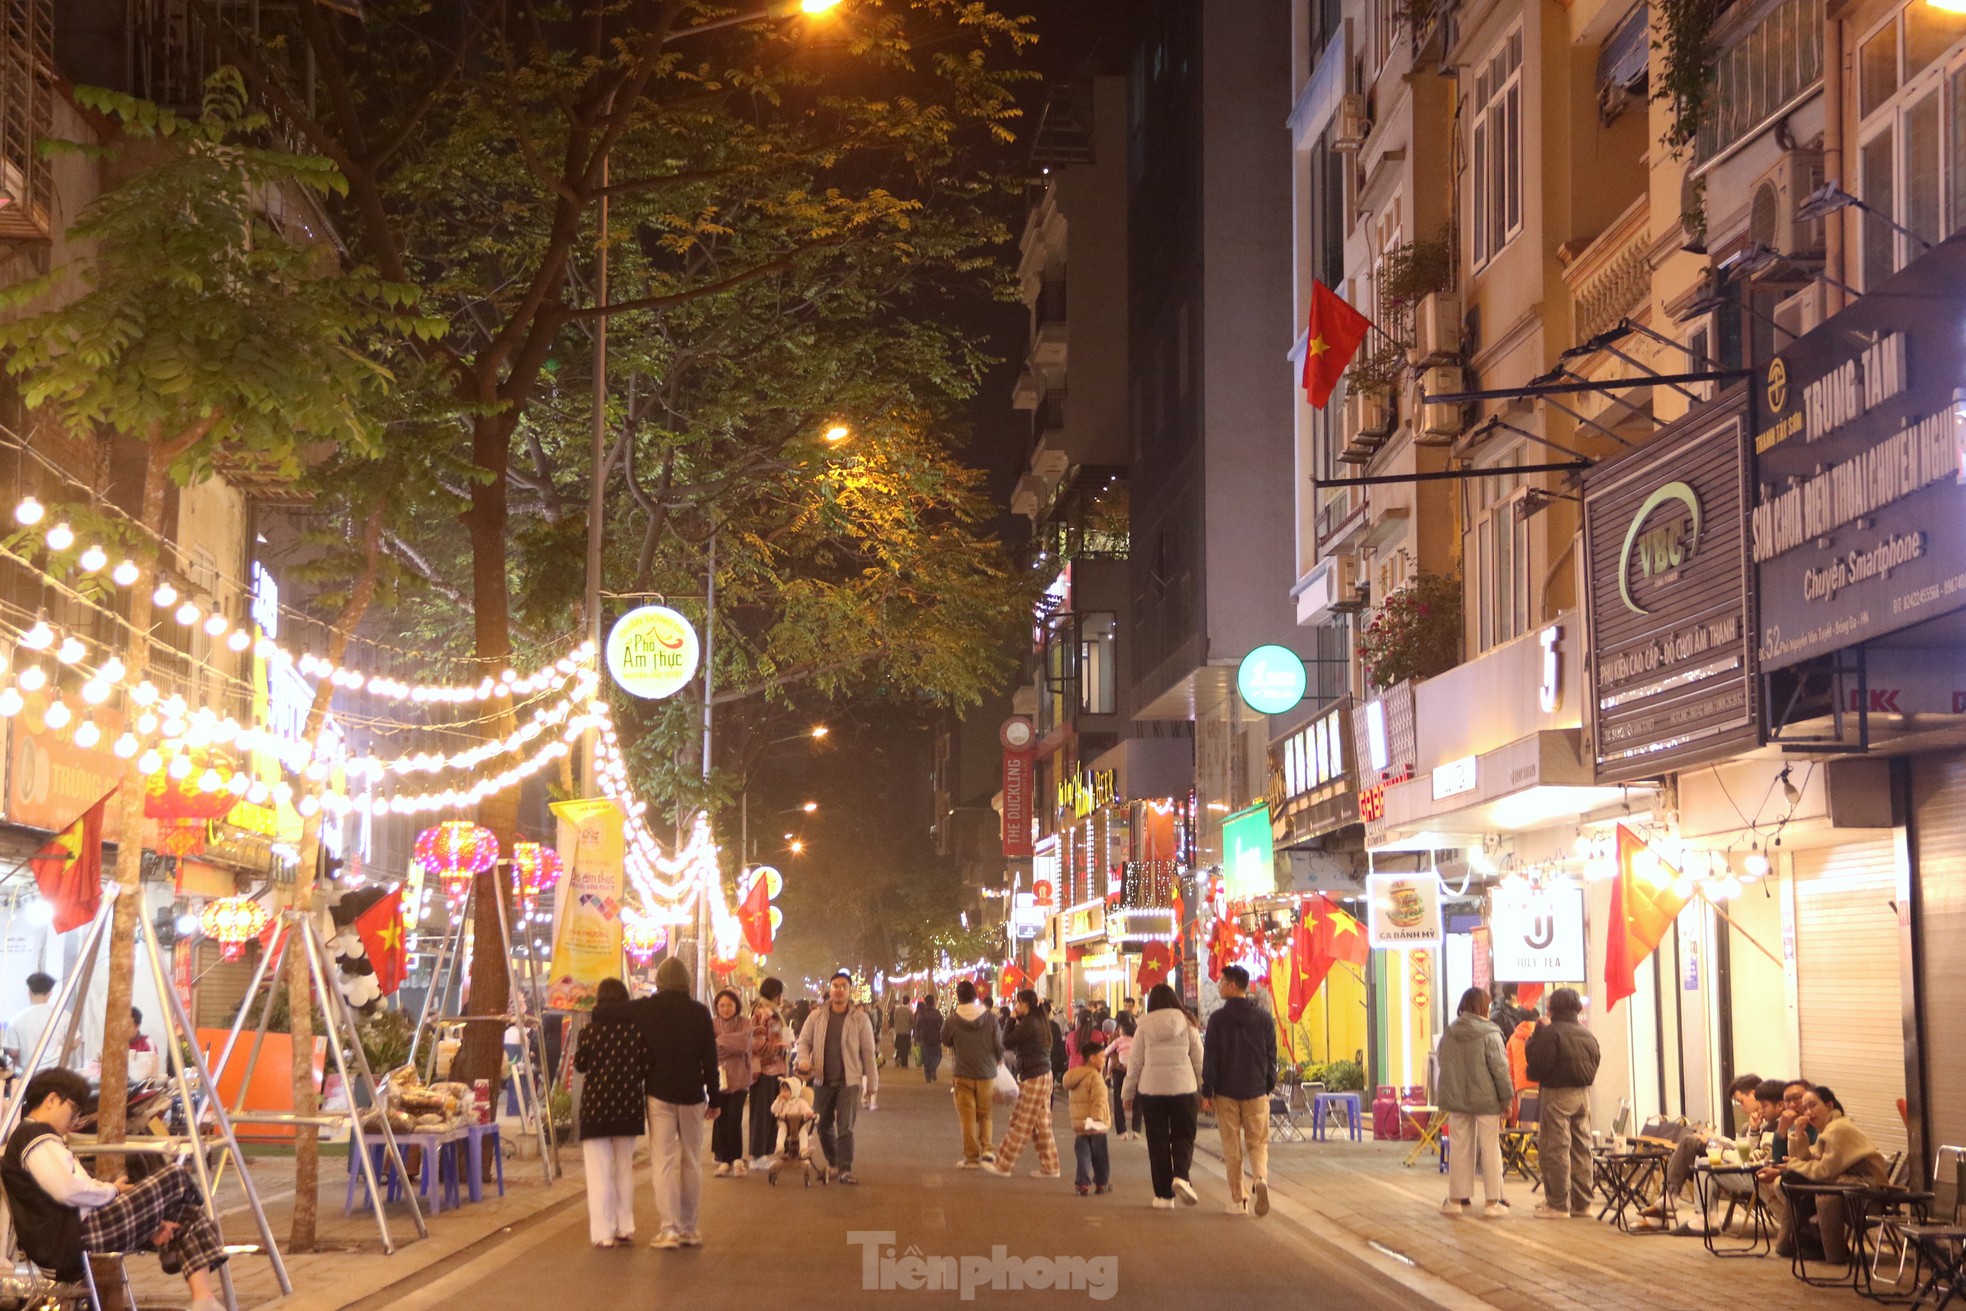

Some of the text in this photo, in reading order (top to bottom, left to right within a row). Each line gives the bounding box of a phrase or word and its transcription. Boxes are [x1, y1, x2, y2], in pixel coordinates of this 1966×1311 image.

[1803, 330, 1901, 443] TRUNG TÂM
[1755, 427, 1775, 455] THANH
[1752, 483, 1774, 563] SỬA
[1774, 475, 1803, 554] CHỮA
[1804, 463, 1831, 549] ĐIỆN
[1832, 451, 1868, 530] THOẠI
[1869, 416, 1919, 511] CHUYÊN
[1638, 519, 1684, 578] VBC
[1804, 531, 1920, 602] Chuyên Smartphone
[1630, 652, 1644, 676] CAO
[1766, 624, 1781, 658] 52
[1007, 759, 1021, 845] THE DUCKLING
[1393, 929, 1420, 939] BÁNH
[1517, 957, 1561, 967] JULY TEA
